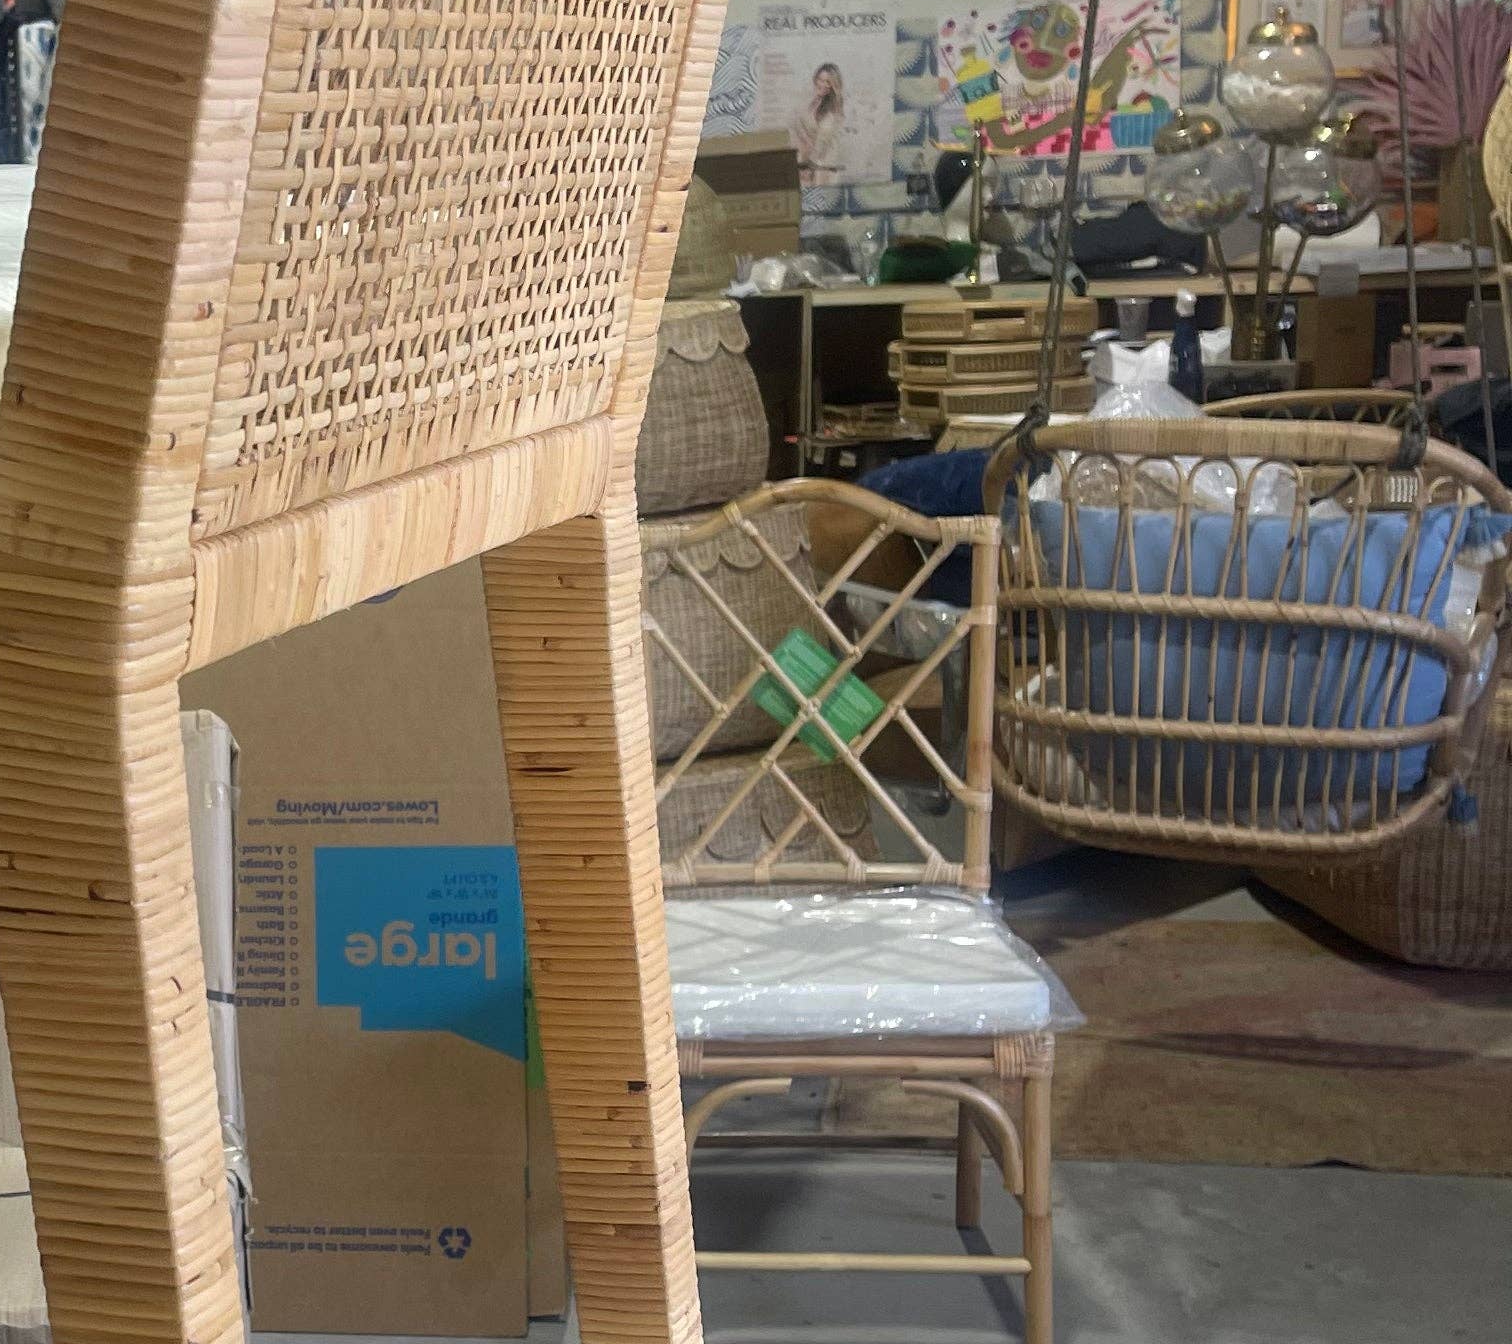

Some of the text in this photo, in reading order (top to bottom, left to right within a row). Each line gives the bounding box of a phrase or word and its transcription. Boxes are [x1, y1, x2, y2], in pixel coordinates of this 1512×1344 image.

[763, 11, 888, 31] REAL PRODUCERS
[276, 799, 440, 816] Lowes.com/Moving
[429, 908, 498, 928] grande
[344, 920, 497, 981] large
